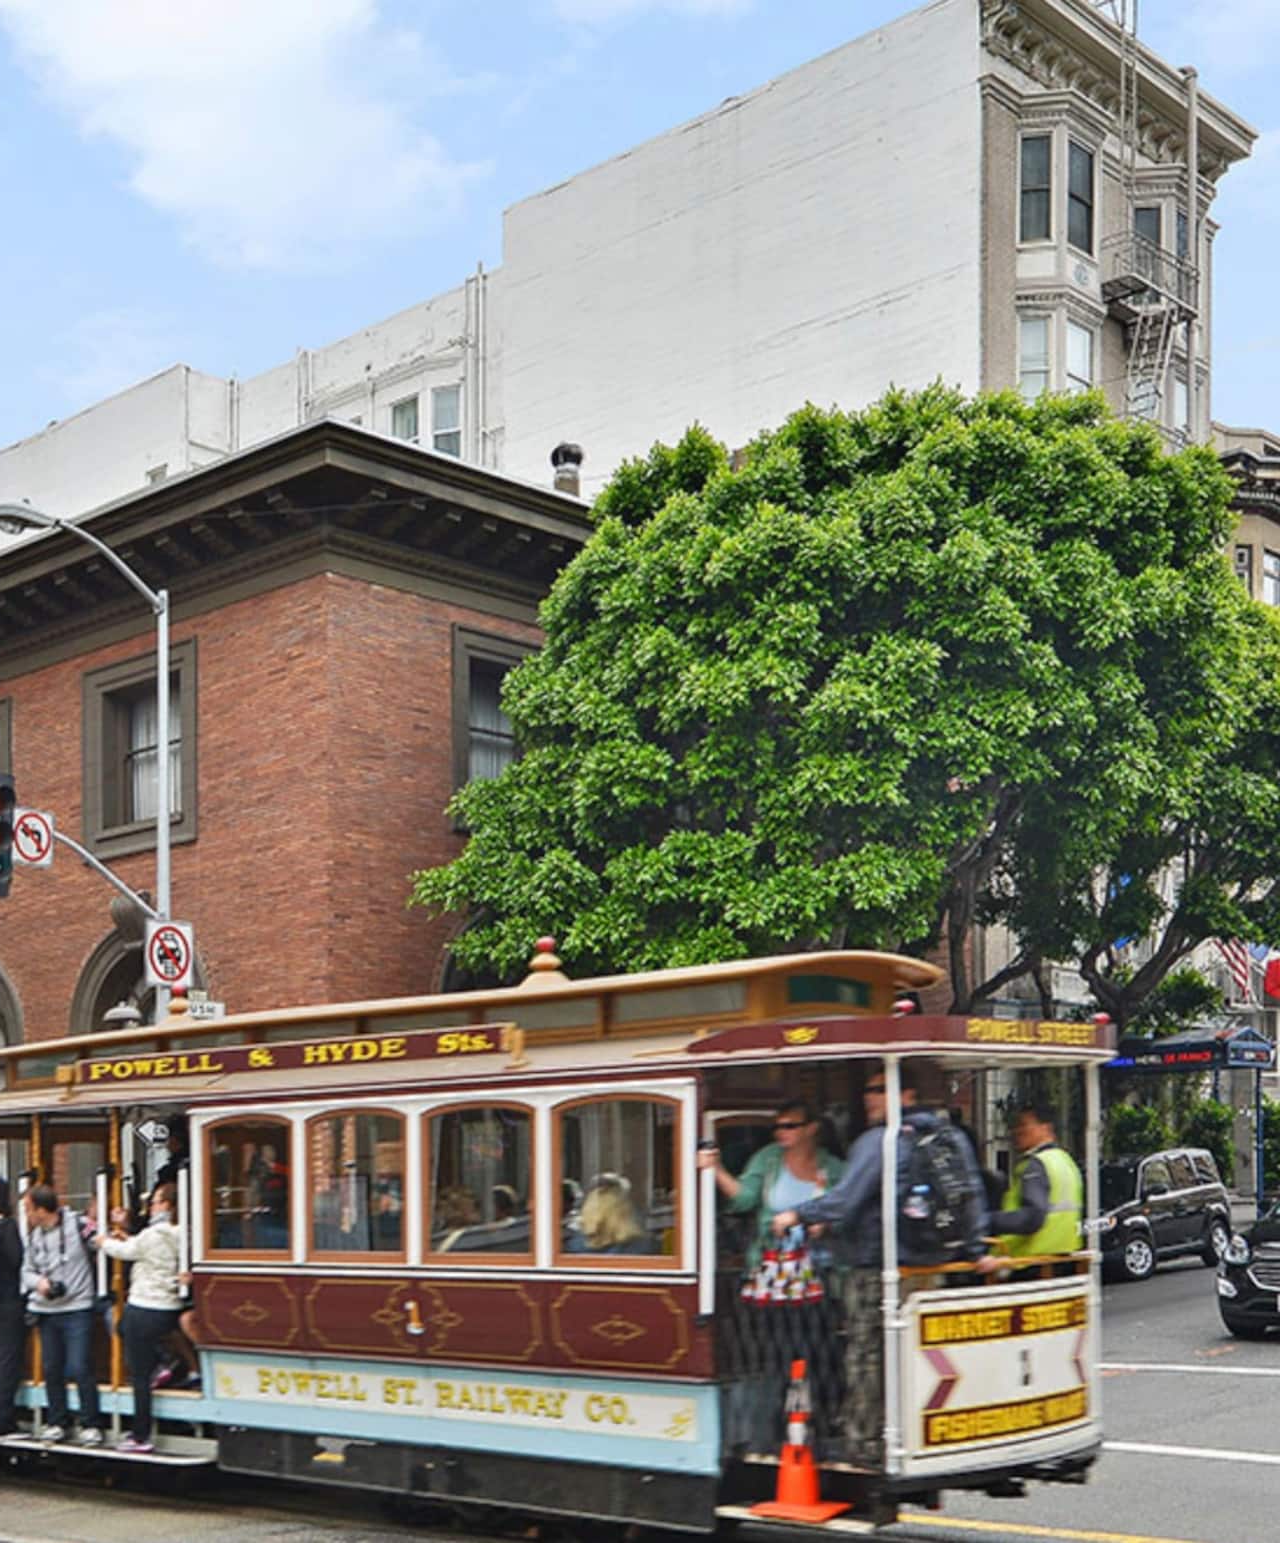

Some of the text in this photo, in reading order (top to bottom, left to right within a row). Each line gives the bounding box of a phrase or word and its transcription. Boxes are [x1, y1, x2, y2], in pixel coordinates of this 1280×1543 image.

[89, 1053, 223, 1081] POWELL
[247, 1047, 273, 1068] &
[303, 1037, 407, 1064] HYDE
[404, 1301, 425, 1335] 1
[256, 1368, 367, 1401] POWELL
[435, 1381, 569, 1420] RAILWAY
[584, 1393, 637, 1425] CO.
